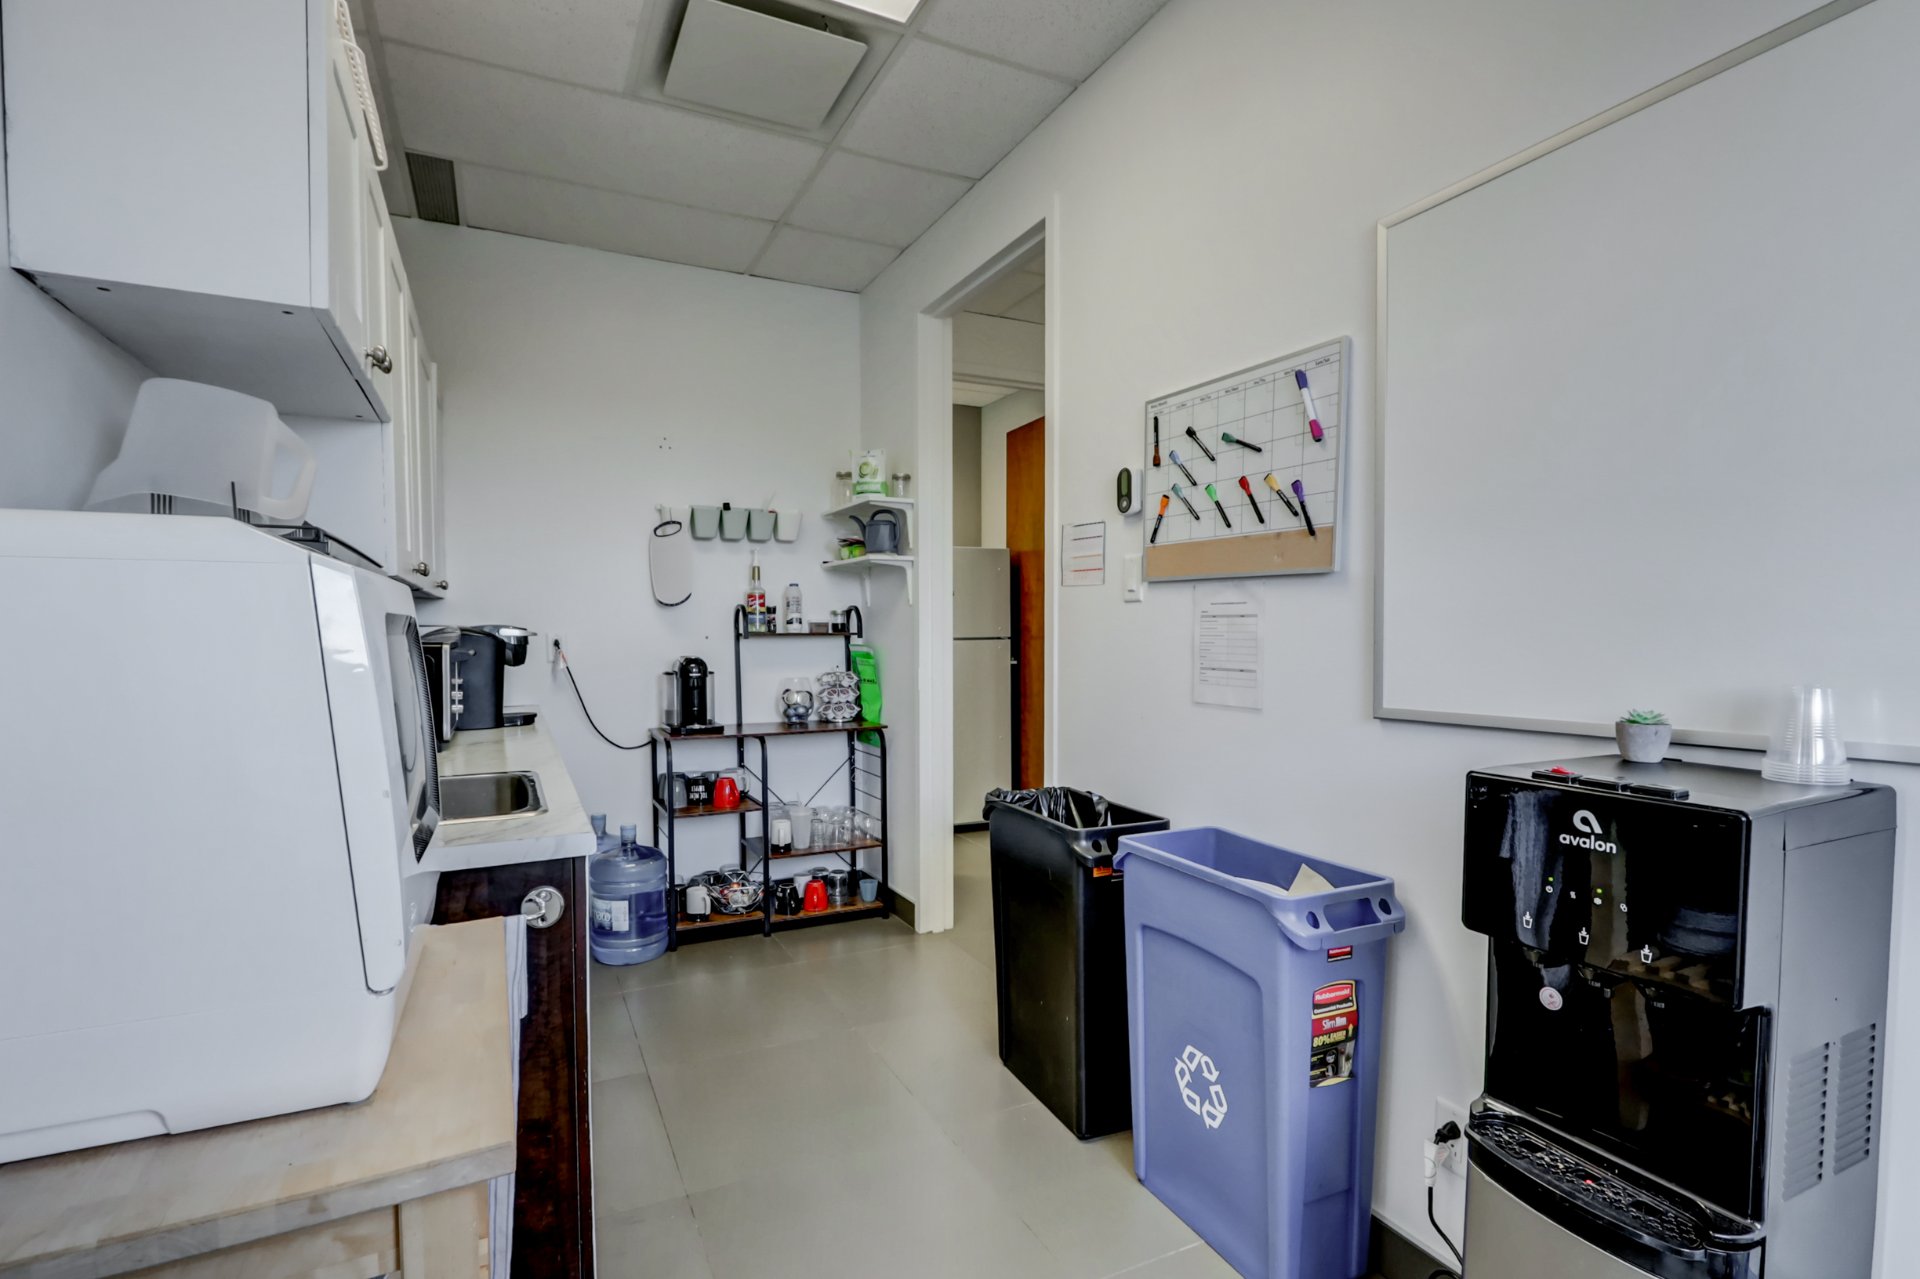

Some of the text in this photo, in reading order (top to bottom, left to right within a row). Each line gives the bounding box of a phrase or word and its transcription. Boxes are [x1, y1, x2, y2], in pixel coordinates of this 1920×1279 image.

[1559, 833, 1617, 854] avalon
[1315, 988, 1350, 1001] Rubbermaid
[1312, 1033, 1331, 1048] 80%
